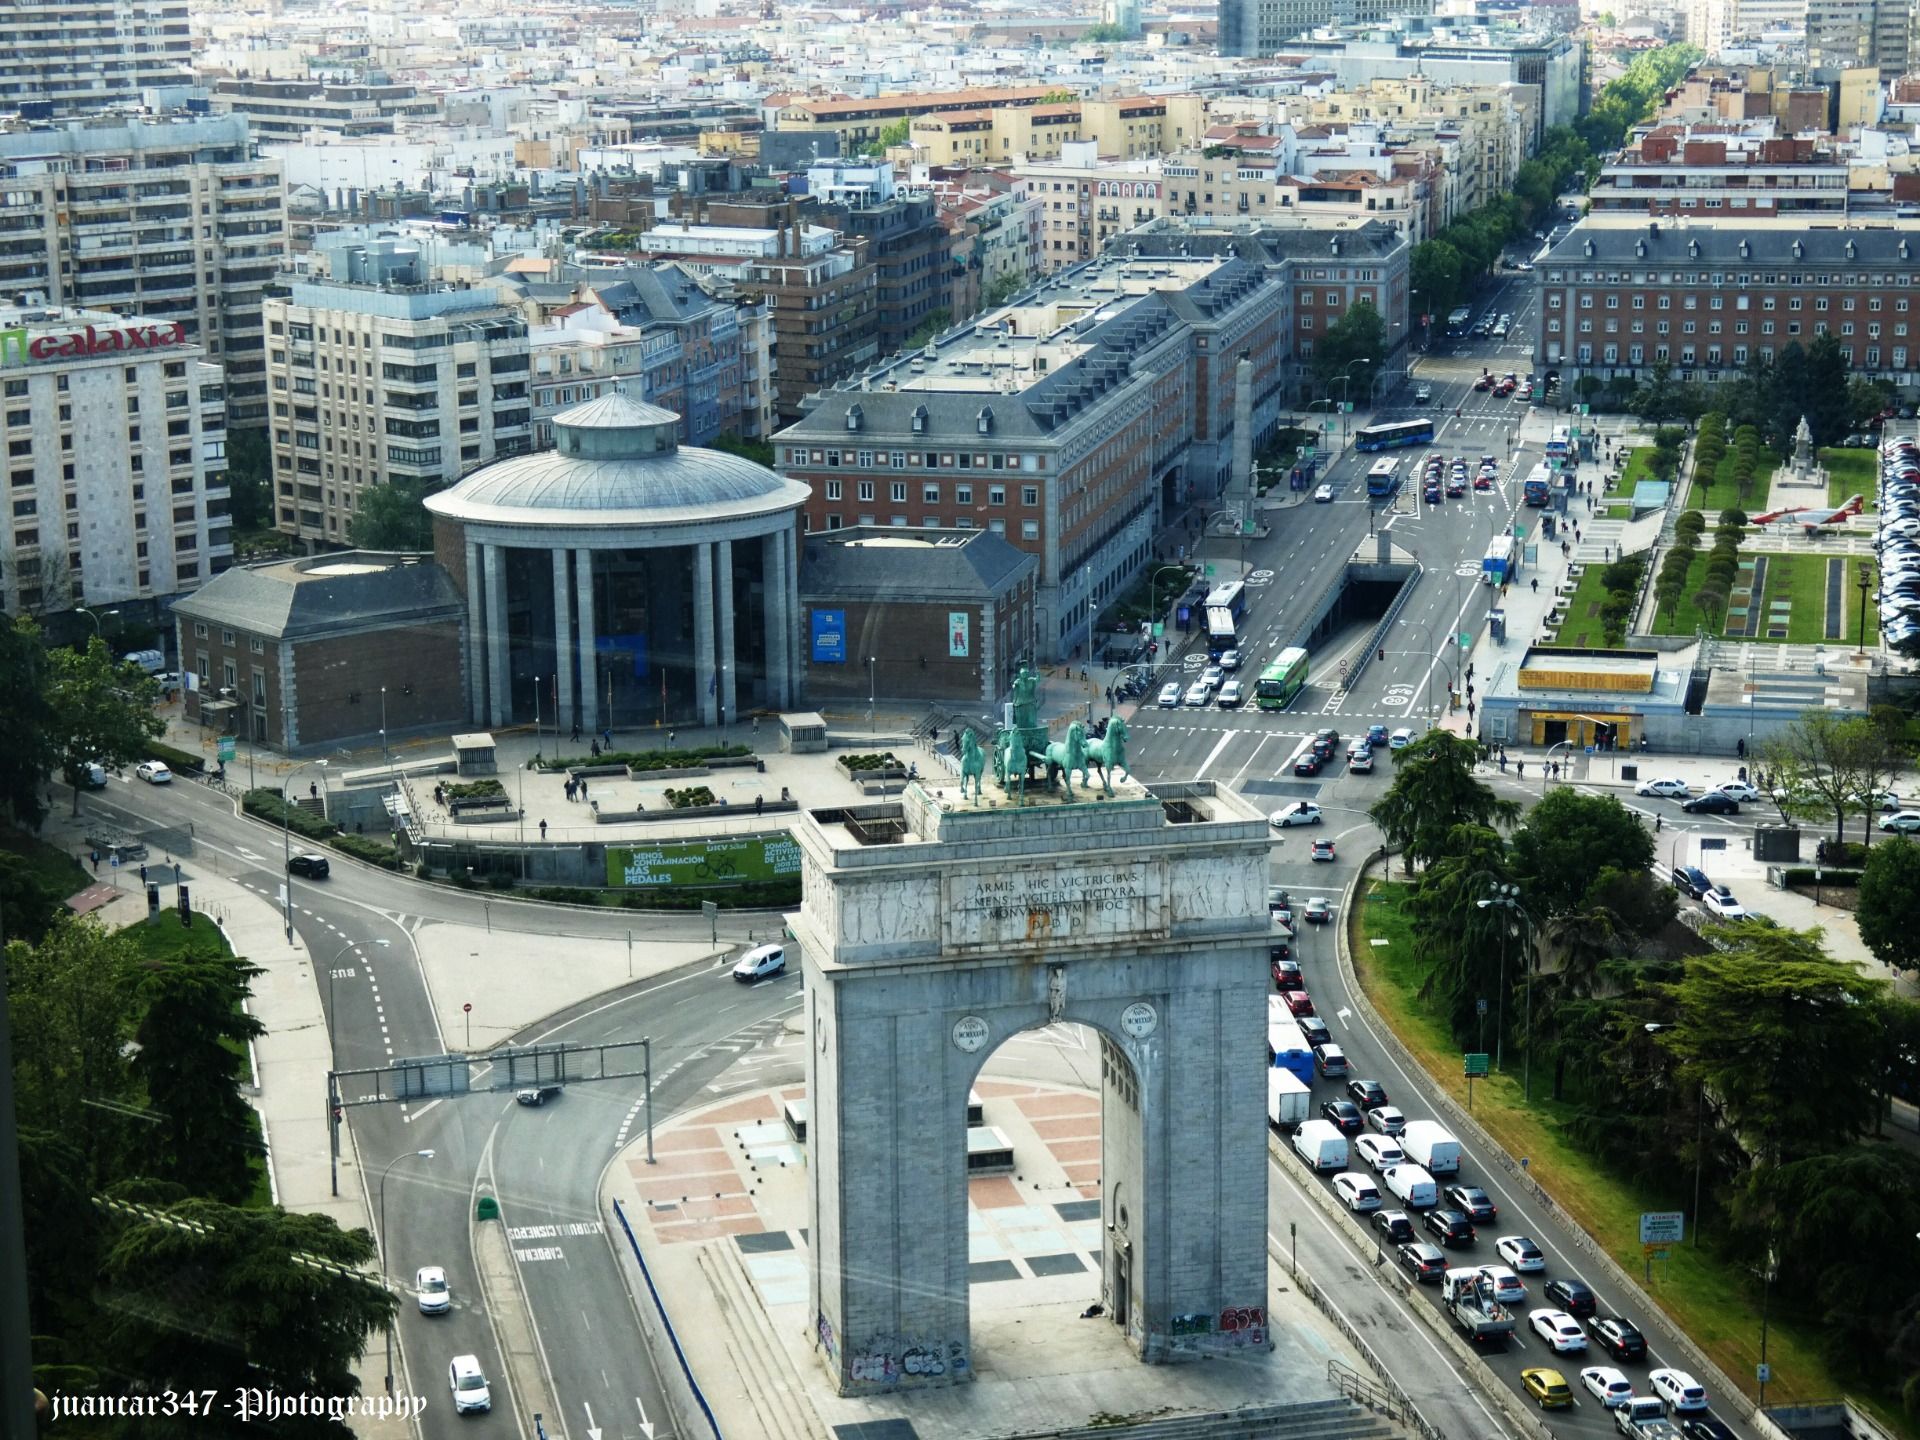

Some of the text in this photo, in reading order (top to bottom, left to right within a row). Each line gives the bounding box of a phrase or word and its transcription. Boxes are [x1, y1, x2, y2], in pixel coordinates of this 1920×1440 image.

[633, 852, 663, 860] MENOS
[633, 855, 705, 867] CONTAMINACIÓN
[764, 856, 775, 864] DE
[625, 874, 671, 885] PEDALES
[976, 872, 1137, 893] ARMIS HIC VICTRICIBVS
[975, 895, 1008, 907] MENS
[1081, 886, 1136, 900] VICTVRA
[989, 900, 1124, 920] MONVMENTVM HOC
[1032, 917, 1081, 929] D D D
[329, 968, 356, 979] BUS
[507, 1225, 557, 1240] CISNEROS
[515, 1247, 563, 1262] CARDENAL
